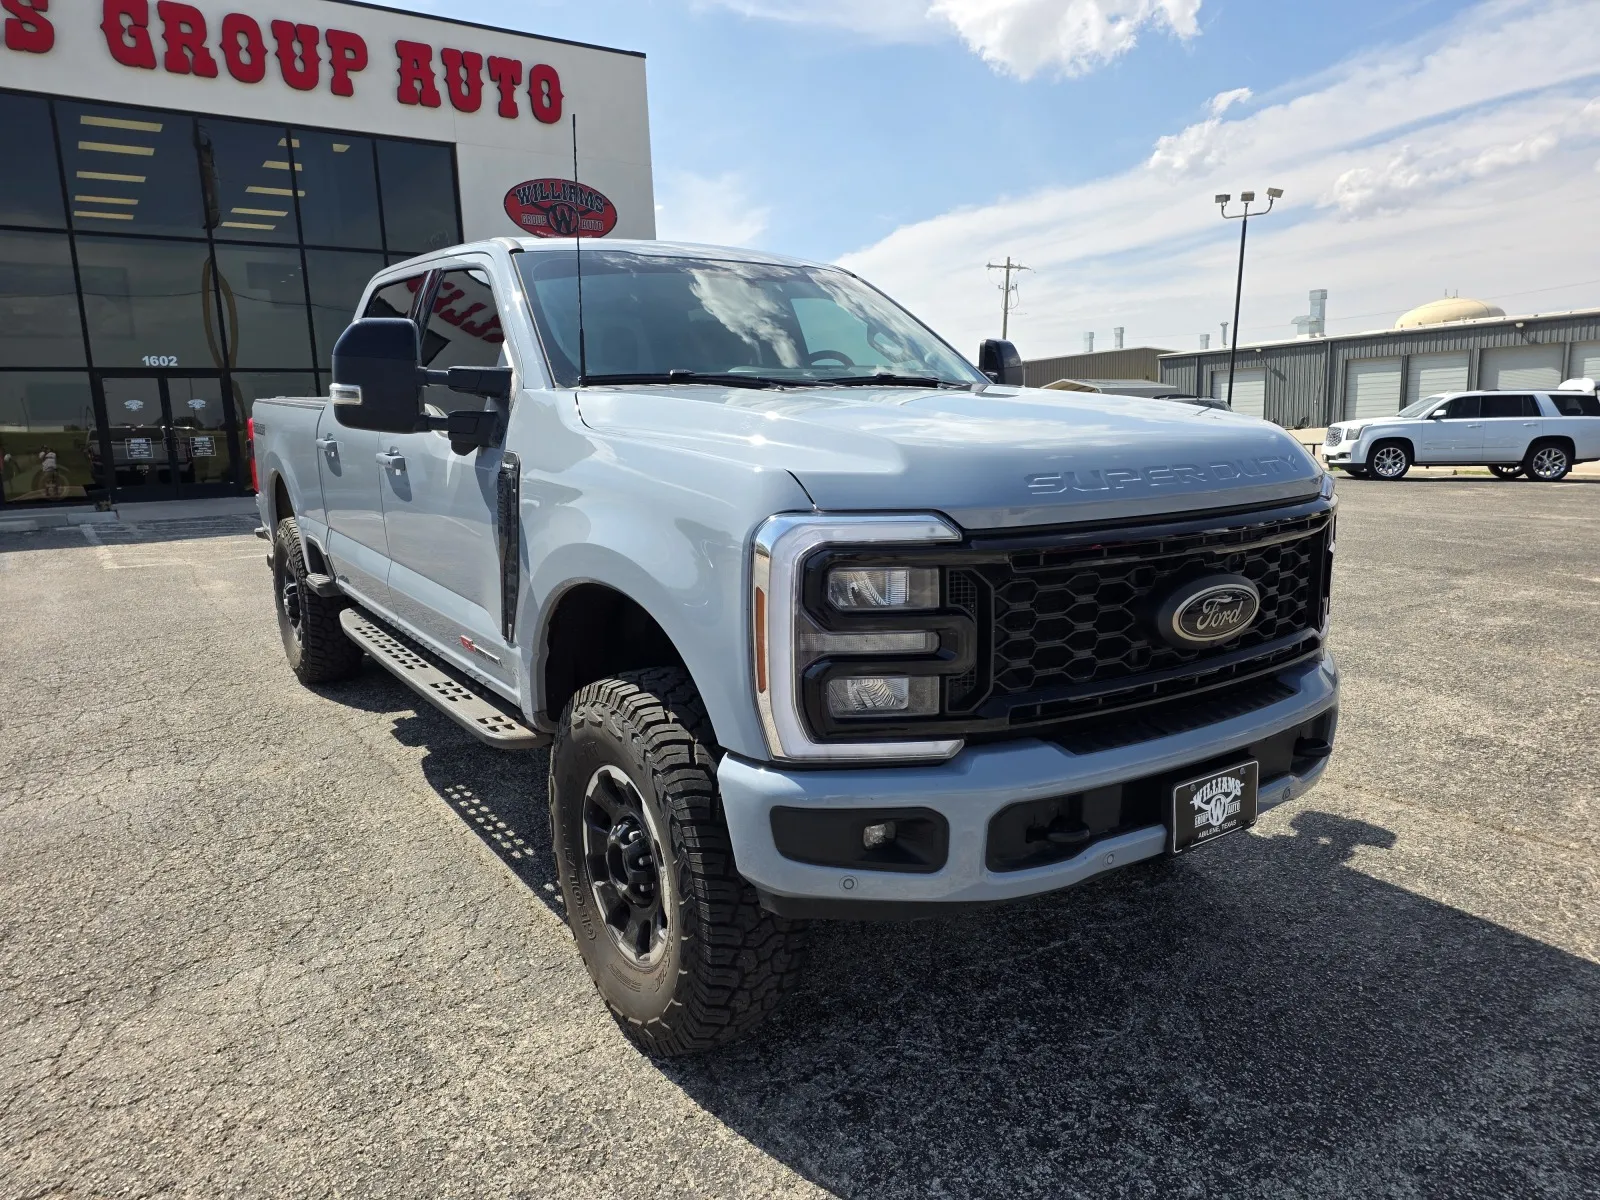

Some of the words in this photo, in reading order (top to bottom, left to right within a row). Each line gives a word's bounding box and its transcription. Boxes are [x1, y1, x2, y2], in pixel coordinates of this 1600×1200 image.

[100, 0, 369, 98] GROUP
[395, 39, 565, 125] AUTO
[515, 182, 605, 214] WILLIAMS
[522, 214, 547, 225] GROUP
[581, 219, 604, 231] AUTO
[142, 355, 178, 367] 1602
[1023, 463, 1207, 495] SUPER
[1210, 454, 1300, 481] DUTY
[1196, 596, 1244, 631] Ford
[1192, 776, 1242, 811] WILLIAMS
